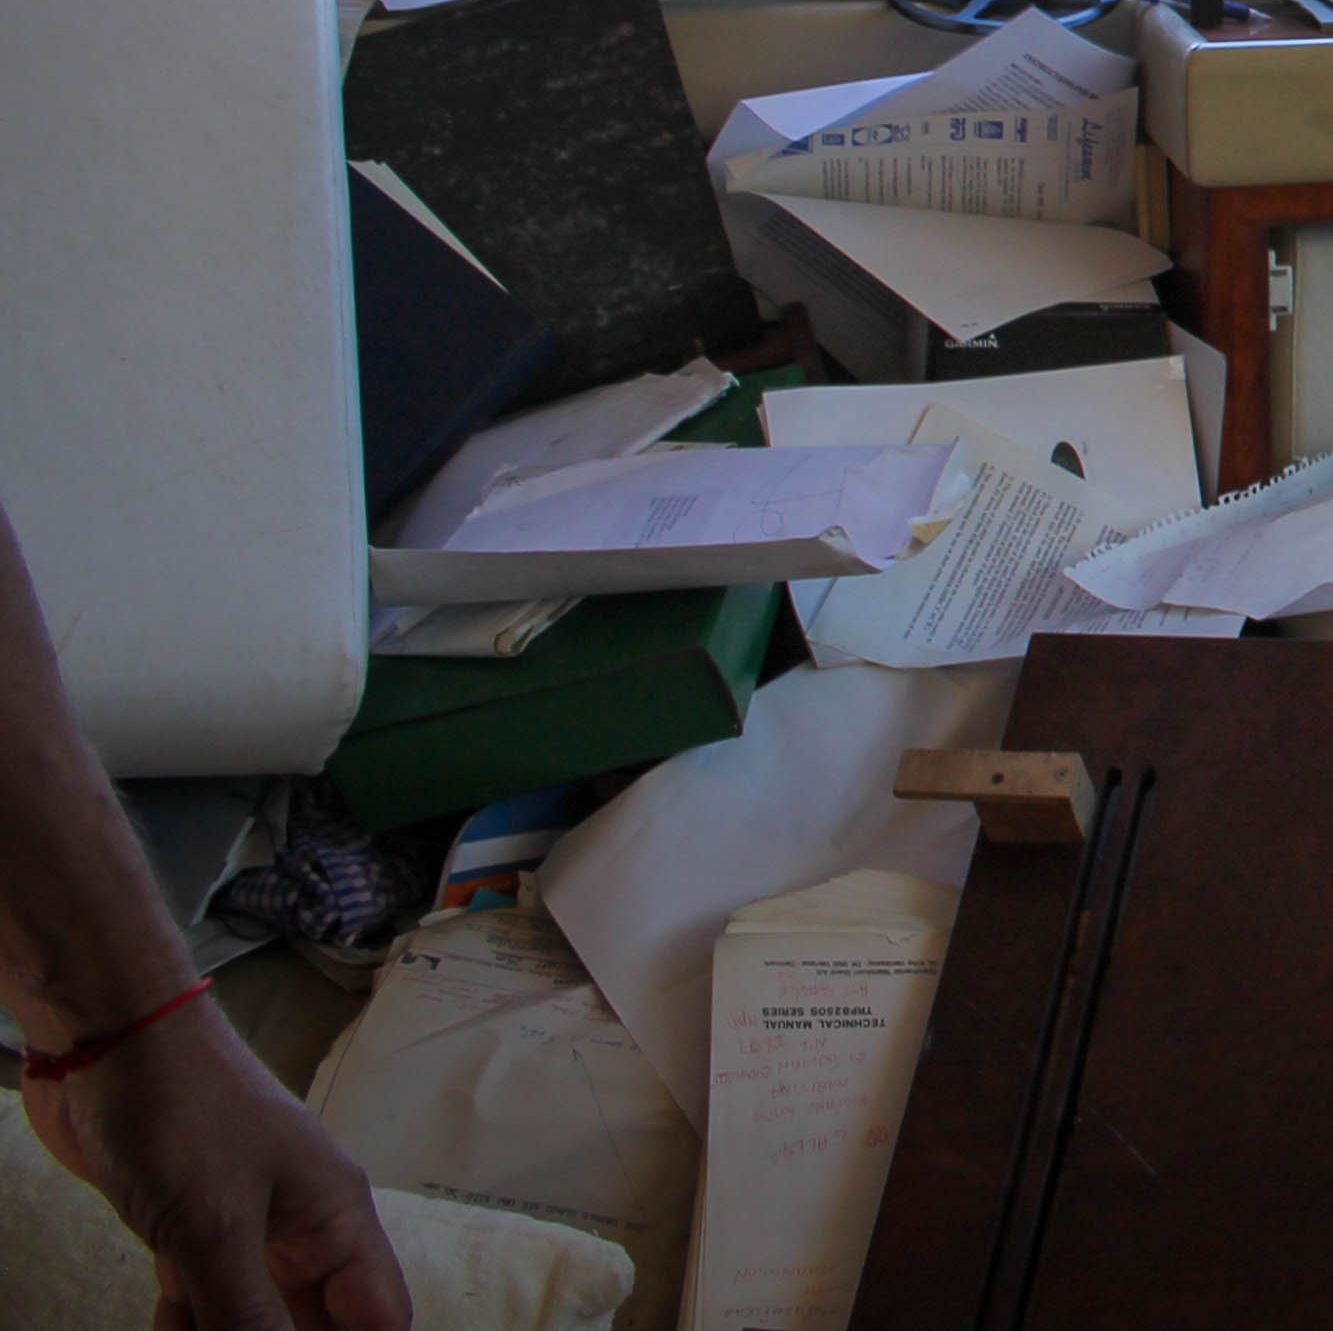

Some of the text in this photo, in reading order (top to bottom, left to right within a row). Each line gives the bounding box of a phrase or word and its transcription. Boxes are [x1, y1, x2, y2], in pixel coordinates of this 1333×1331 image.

[762, 1006, 805, 1016] SERIES
[762, 1018, 812, 1029] MANUAL
[819, 1018, 886, 1029] TECHNICAL
